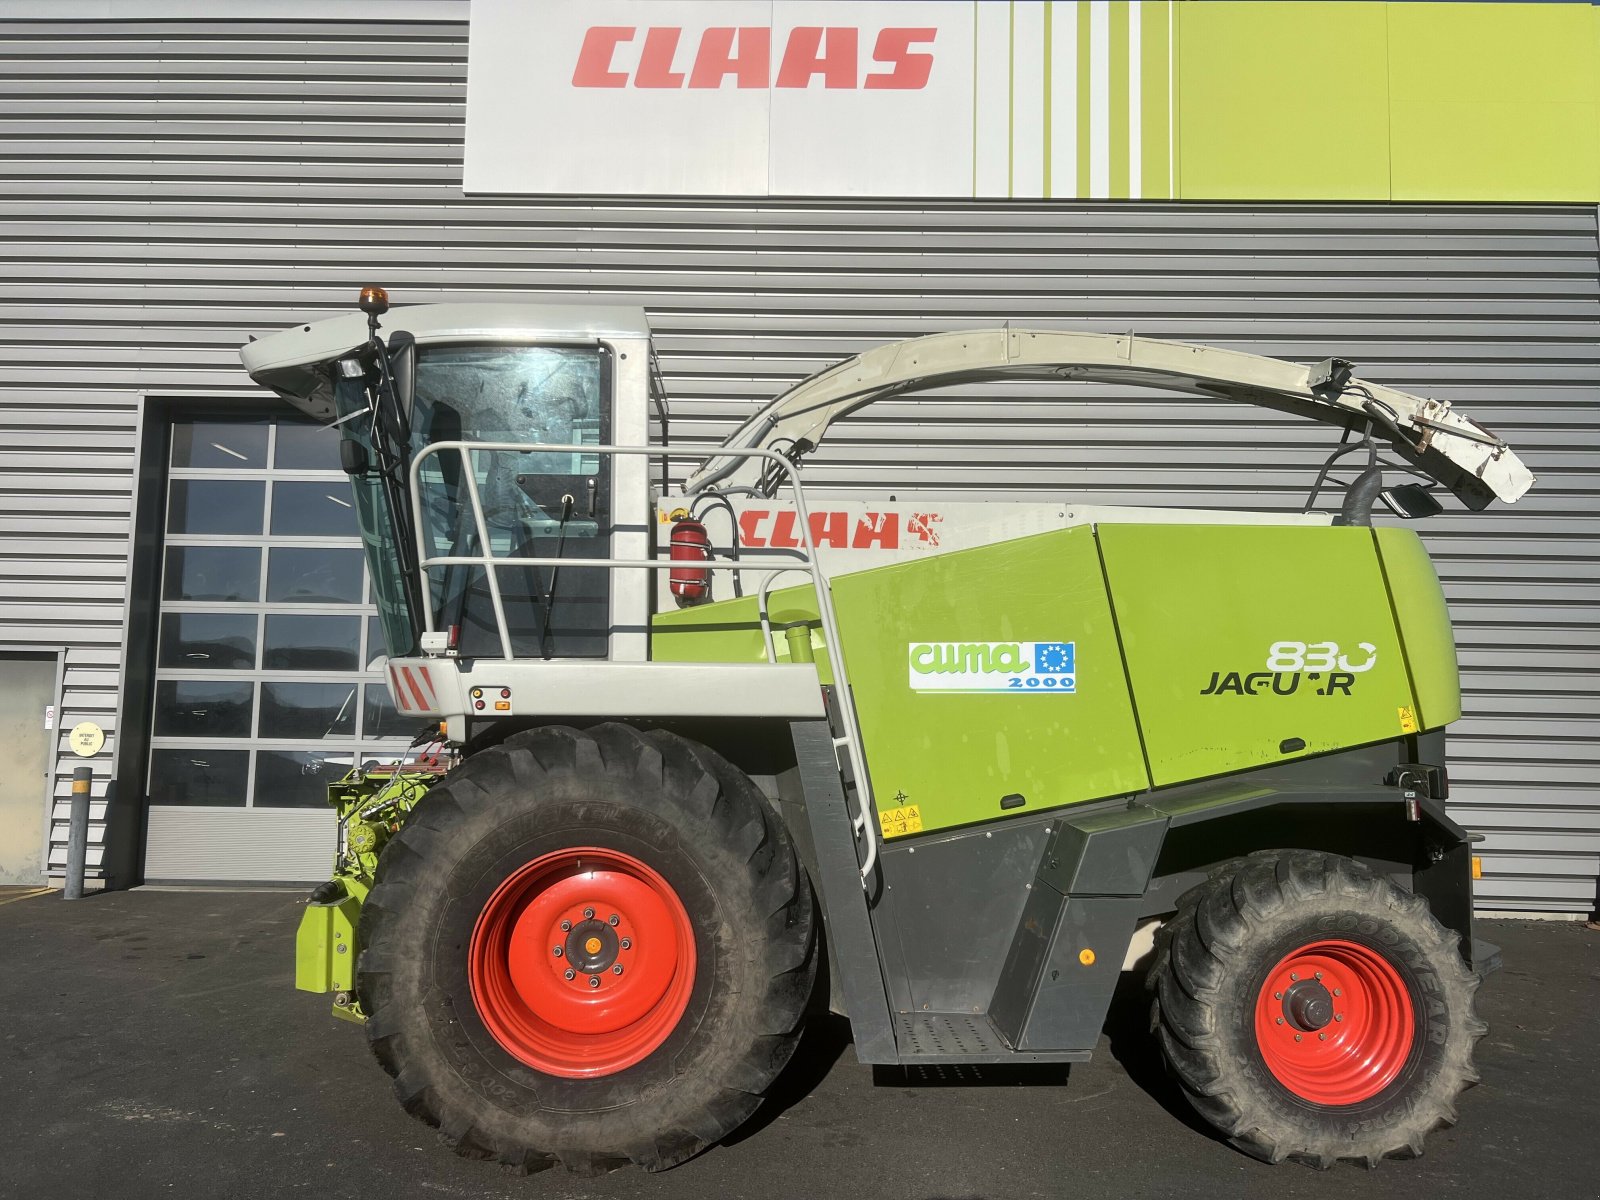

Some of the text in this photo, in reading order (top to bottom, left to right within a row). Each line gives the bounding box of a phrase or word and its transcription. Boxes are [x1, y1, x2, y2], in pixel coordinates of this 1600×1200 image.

[571, 26, 938, 90] CLAAS
[1266, 641, 1377, 672] 830
[1008, 677, 1074, 688] 2000
[1200, 671, 1356, 696] JAGUR
